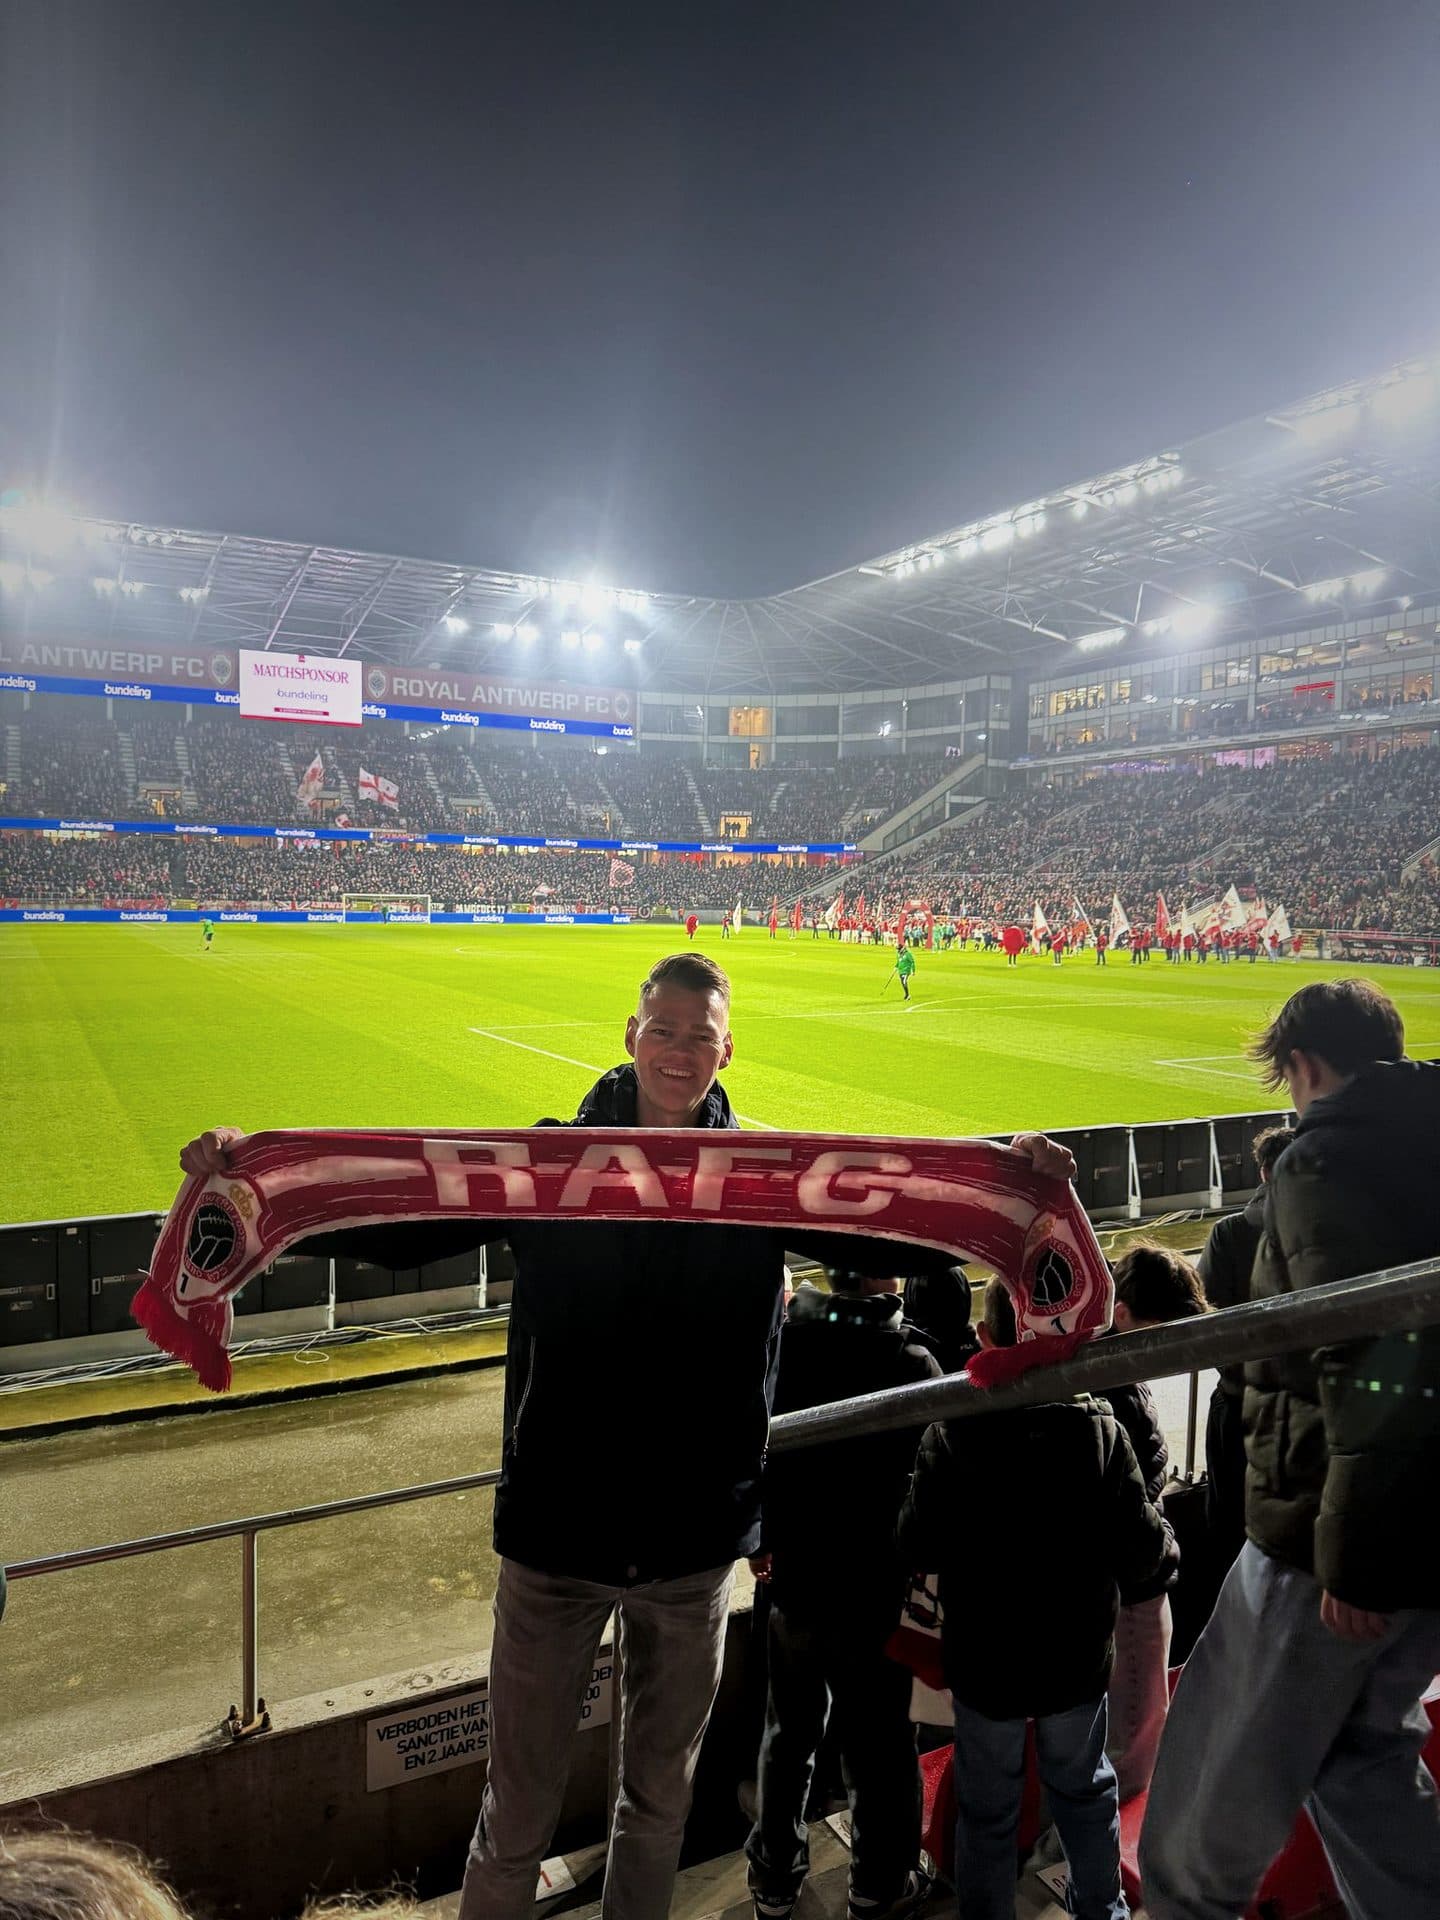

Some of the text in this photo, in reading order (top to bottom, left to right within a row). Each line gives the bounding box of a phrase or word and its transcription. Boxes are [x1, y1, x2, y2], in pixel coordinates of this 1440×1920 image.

[20, 643, 163, 674] ANTWERP
[171, 656, 204, 678] FC
[252, 663, 350, 684] MATCHSPONSOR
[104, 683, 152, 700] bundeling
[277, 688, 329, 703] bundeling
[392, 677, 609, 714] ROYAL ANTWERP FC
[441, 711, 479, 726] bundeling
[530, 718, 566, 733] bundeling
[424, 1138, 913, 1217] RAFC
[180, 1272, 189, 1294] 1
[376, 1707, 458, 1741] VERBODEN
[460, 1699, 488, 1719] HET
[396, 1725, 460, 1754] SANCTIE
[461, 1717, 488, 1736] VAN
[405, 1751, 425, 1770] EN
[427, 1749, 437, 1764] 2
[438, 1738, 476, 1761] JAAR
